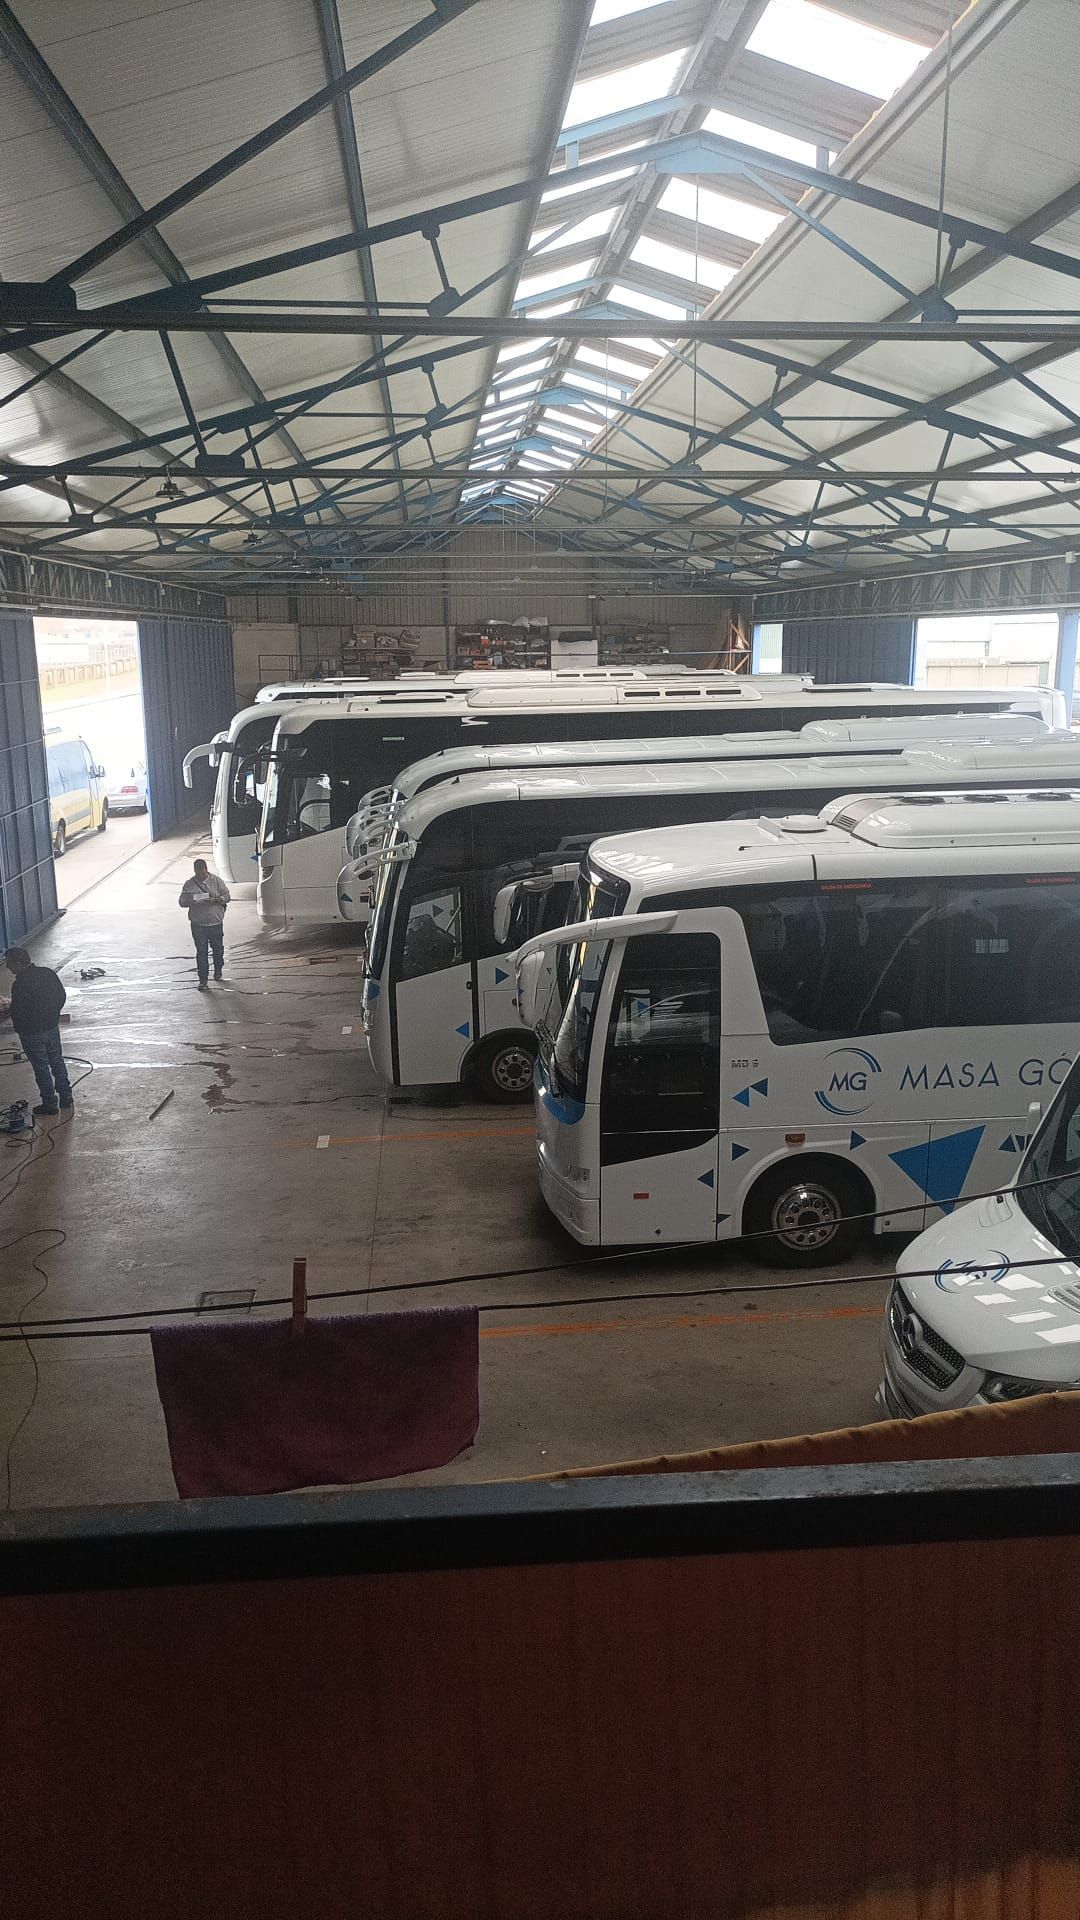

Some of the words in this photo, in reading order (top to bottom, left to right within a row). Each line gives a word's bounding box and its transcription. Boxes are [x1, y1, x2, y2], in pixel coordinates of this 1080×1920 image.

[829, 1071, 867, 1091] MG
[899, 1061, 1000, 1091] MASA
[1018, 1053, 1074, 1086] GÓ
